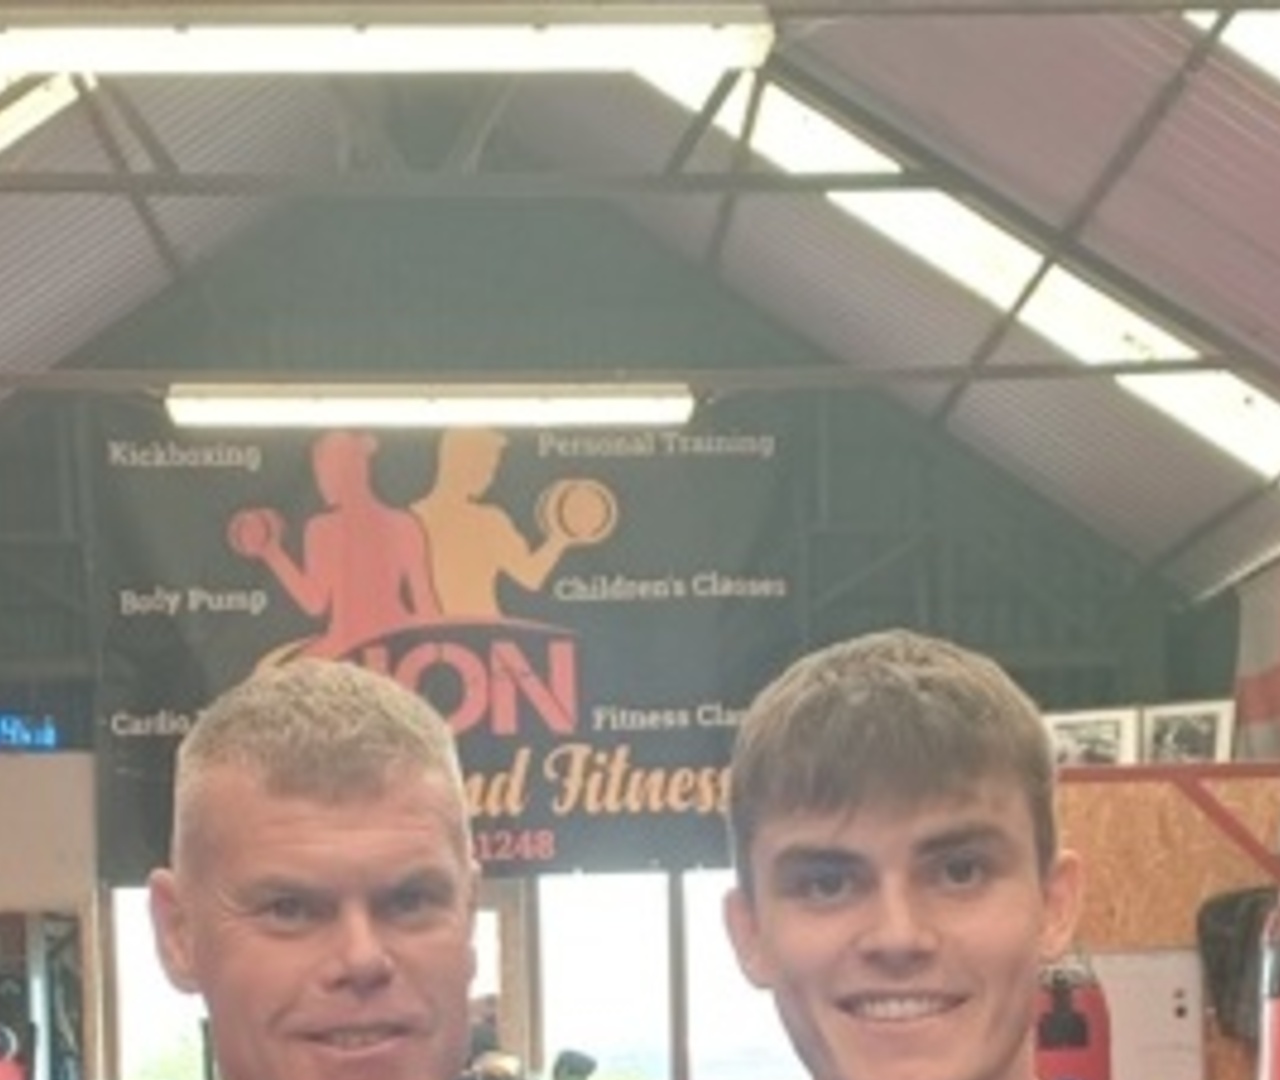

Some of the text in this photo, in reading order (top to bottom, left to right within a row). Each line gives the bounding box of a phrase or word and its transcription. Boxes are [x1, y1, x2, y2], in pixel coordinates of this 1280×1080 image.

[107, 440, 261, 471] Kickboxing
[538, 430, 775, 458] Personal Training
[554, 569, 787, 600] Children's Classes
[120, 585, 267, 616] Body Pump
[111, 709, 190, 736] Cardio
[592, 705, 689, 732] Fitness
